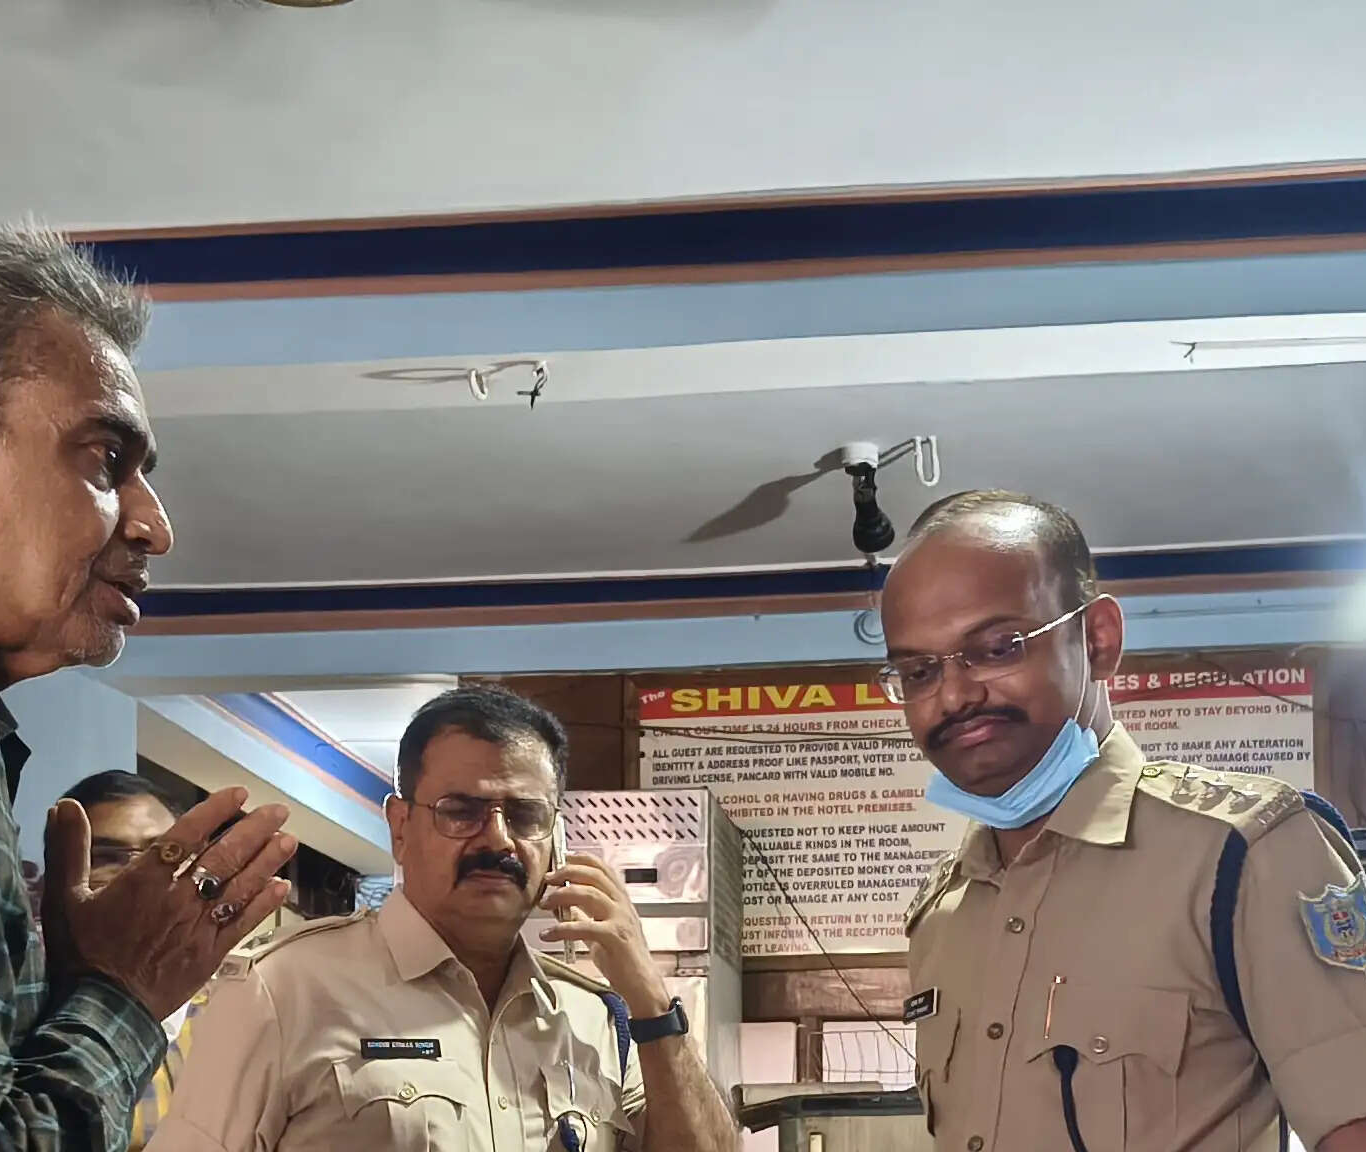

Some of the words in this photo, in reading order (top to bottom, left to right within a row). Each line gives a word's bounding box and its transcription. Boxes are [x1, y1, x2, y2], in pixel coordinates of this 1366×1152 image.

[1147, 672, 1161, 689] &
[640, 691, 666, 707] The
[671, 684, 836, 713] SHIVA
[1150, 710, 1173, 719] NOT
[1177, 708, 1191, 718] TO
[1194, 706, 1222, 717] STAY
[1226, 705, 1272, 716] BEYOND
[1275, 704, 1287, 714] 10
[722, 724, 749, 734] TIME
[783, 721, 823, 733] HOURS
[826, 720, 859, 731] FROM
[862, 718, 902, 729] CHECK
[653, 749, 669, 759] ALL
[672, 747, 702, 759] GUEST
[705, 746, 723, 757] ARE
[726, 744, 782, 756] REQUESTED
[785, 743, 797, 754] TO
[799, 742, 840, 753] PROVIDE
[842, 742, 849, 752] A
[851, 740, 879, 751] VALID
[1165, 742, 1179, 751] TO
[1182, 741, 1211, 751] MAKE
[1214, 740, 1236, 750] ANY
[1239, 738, 1304, 749] ALTERATION
[652, 761, 695, 772] IDENTITY
[698, 760, 705, 770] &
[707, 758, 750, 770] ADDRESS
[753, 757, 784, 769] PROOF
[786, 755, 808, 767] LIKE
[810, 754, 861, 767] PASSPORT,
[863, 752, 894, 765] VOTER
[897, 752, 907, 763] ID
[1181, 753, 1203, 764] ANY
[1205, 752, 1249, 764] DAMAGE
[1252, 751, 1294, 762] CAUSED
[1296, 751, 1311, 762] BY
[653, 774, 691, 786] DRIVING
[693, 773, 735, 785] LICENSE,
[737, 771, 781, 783] PANCARD
[783, 770, 808, 782] WITH
[810, 769, 838, 780] VALID
[840, 768, 876, 779] MOBILE
[879, 767, 895, 778] NO.
[763, 792, 780, 804] OR
[782, 791, 825, 803] HAVING
[828, 790, 867, 801] DRUGS
[870, 789, 877, 800] &
[777, 806, 789, 817] IN
[793, 805, 815, 816] THE
[817, 804, 854, 815] HOTEL
[857, 801, 916, 814] PREMISES.
[796, 826, 819, 838] NOT
[822, 826, 836, 836] TO
[838, 824, 866, 836] KEEP
[869, 823, 898, 835] HUGE
[901, 822, 946, 833] AMOUNT
[805, 839, 838, 851] KINDS
[840, 839, 852, 850] IN
[855, 838, 876, 849] THE
[787, 853, 810, 865] THE
[811, 852, 841, 864] SAME
[843, 852, 857, 863] TO
[860, 851, 881, 862] THE
[773, 867, 794, 879] THE
[796, 865, 855, 877] DEPOSITED
[857, 864, 895, 876] MONEY
[898, 863, 913, 875] OR
[792, 879, 854, 891] OVERRULED
[742, 895, 765, 906] OST
[767, 894, 782, 905] OR
[784, 893, 828, 905] DAMAGE
[830, 893, 844, 904] AT
[847, 892, 869, 904] ANY
[871, 891, 900, 902] COST
[810, 913, 852, 926] RETURN
[854, 912, 868, 924] BY
[872, 912, 884, 924] 10
[764, 928, 804, 940] INFORM
[823, 926, 843, 938] THE
